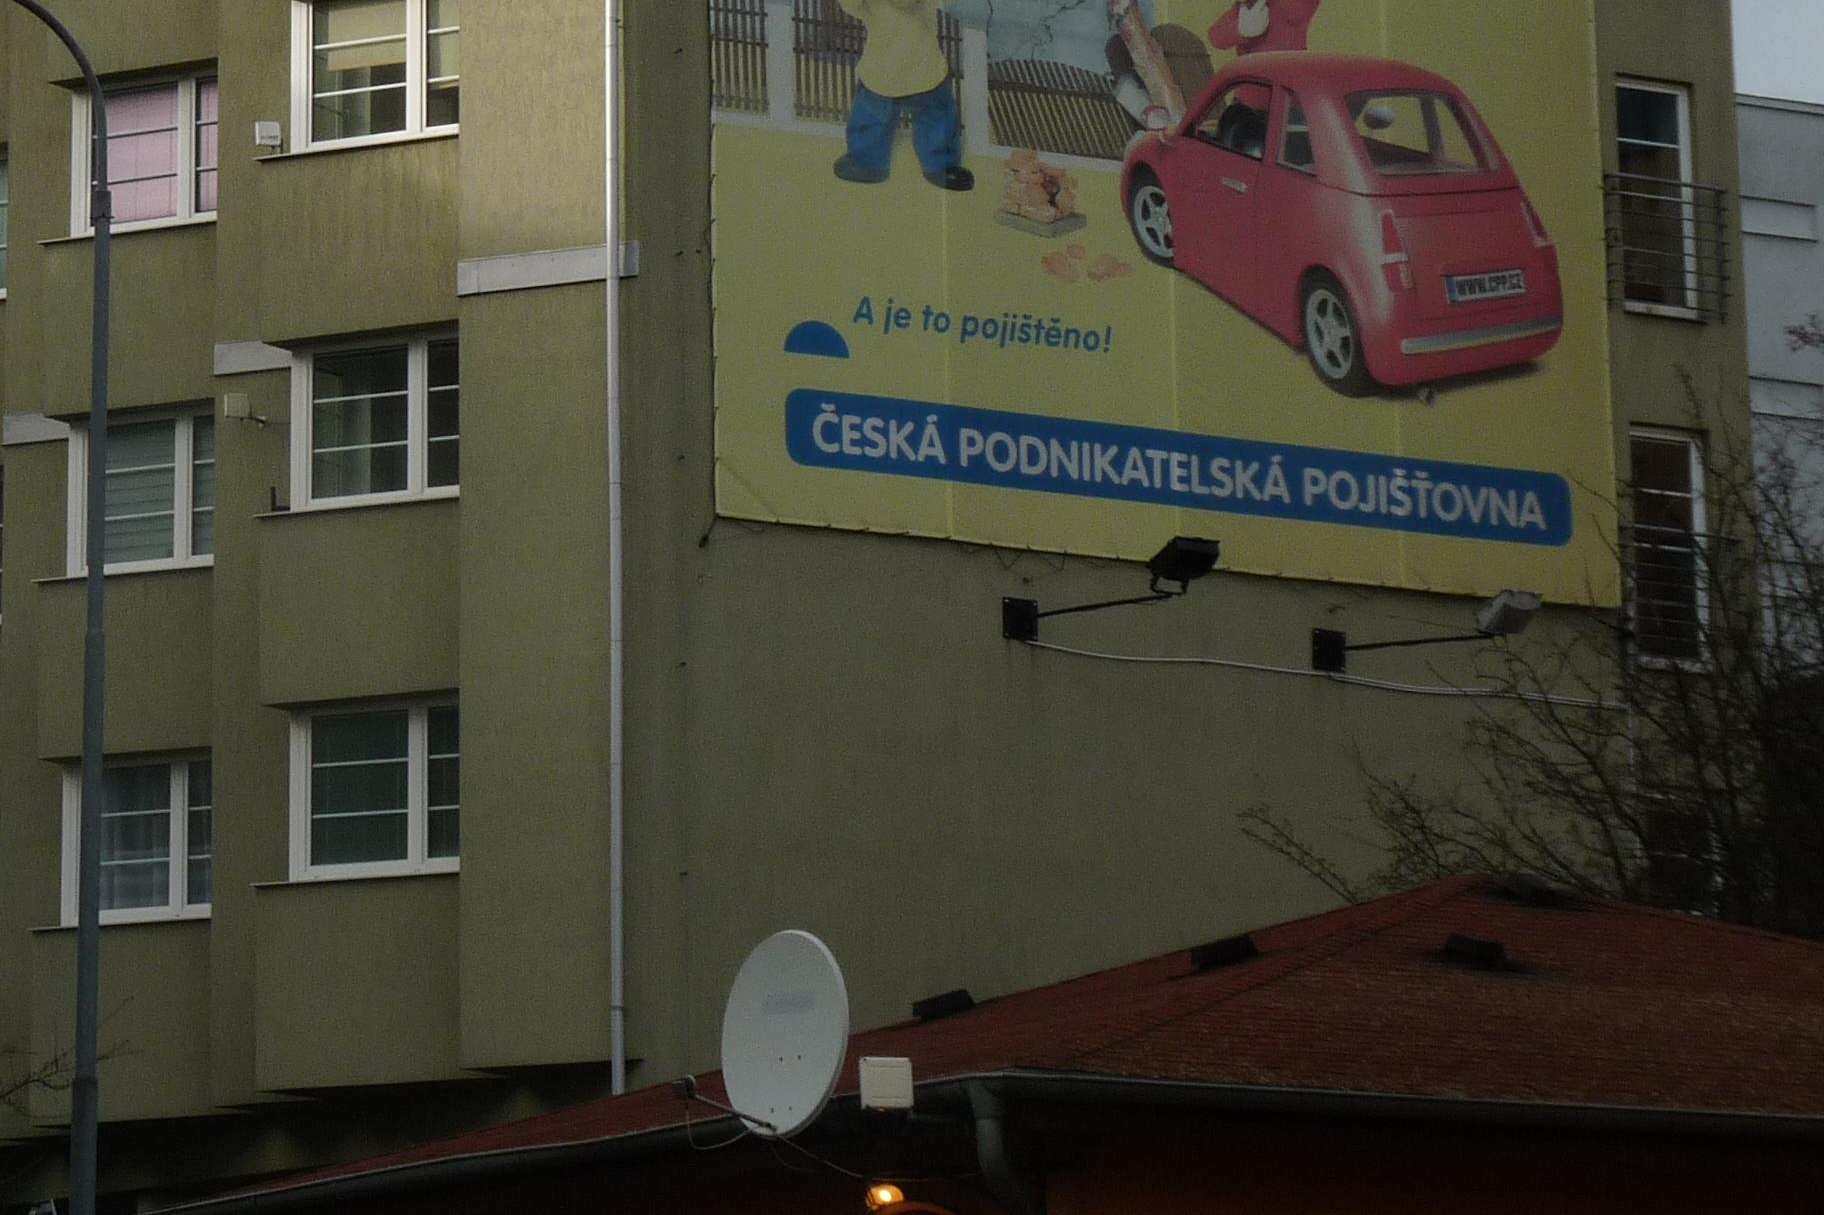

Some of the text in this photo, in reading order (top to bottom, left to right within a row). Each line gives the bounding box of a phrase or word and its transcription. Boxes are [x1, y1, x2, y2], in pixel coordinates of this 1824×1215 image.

[853, 296, 1114, 354] A je to pojištěno!
[812, 402, 1548, 531] ČESKÁ PODNIKATELSKÁ POJIŠŤOVNA
